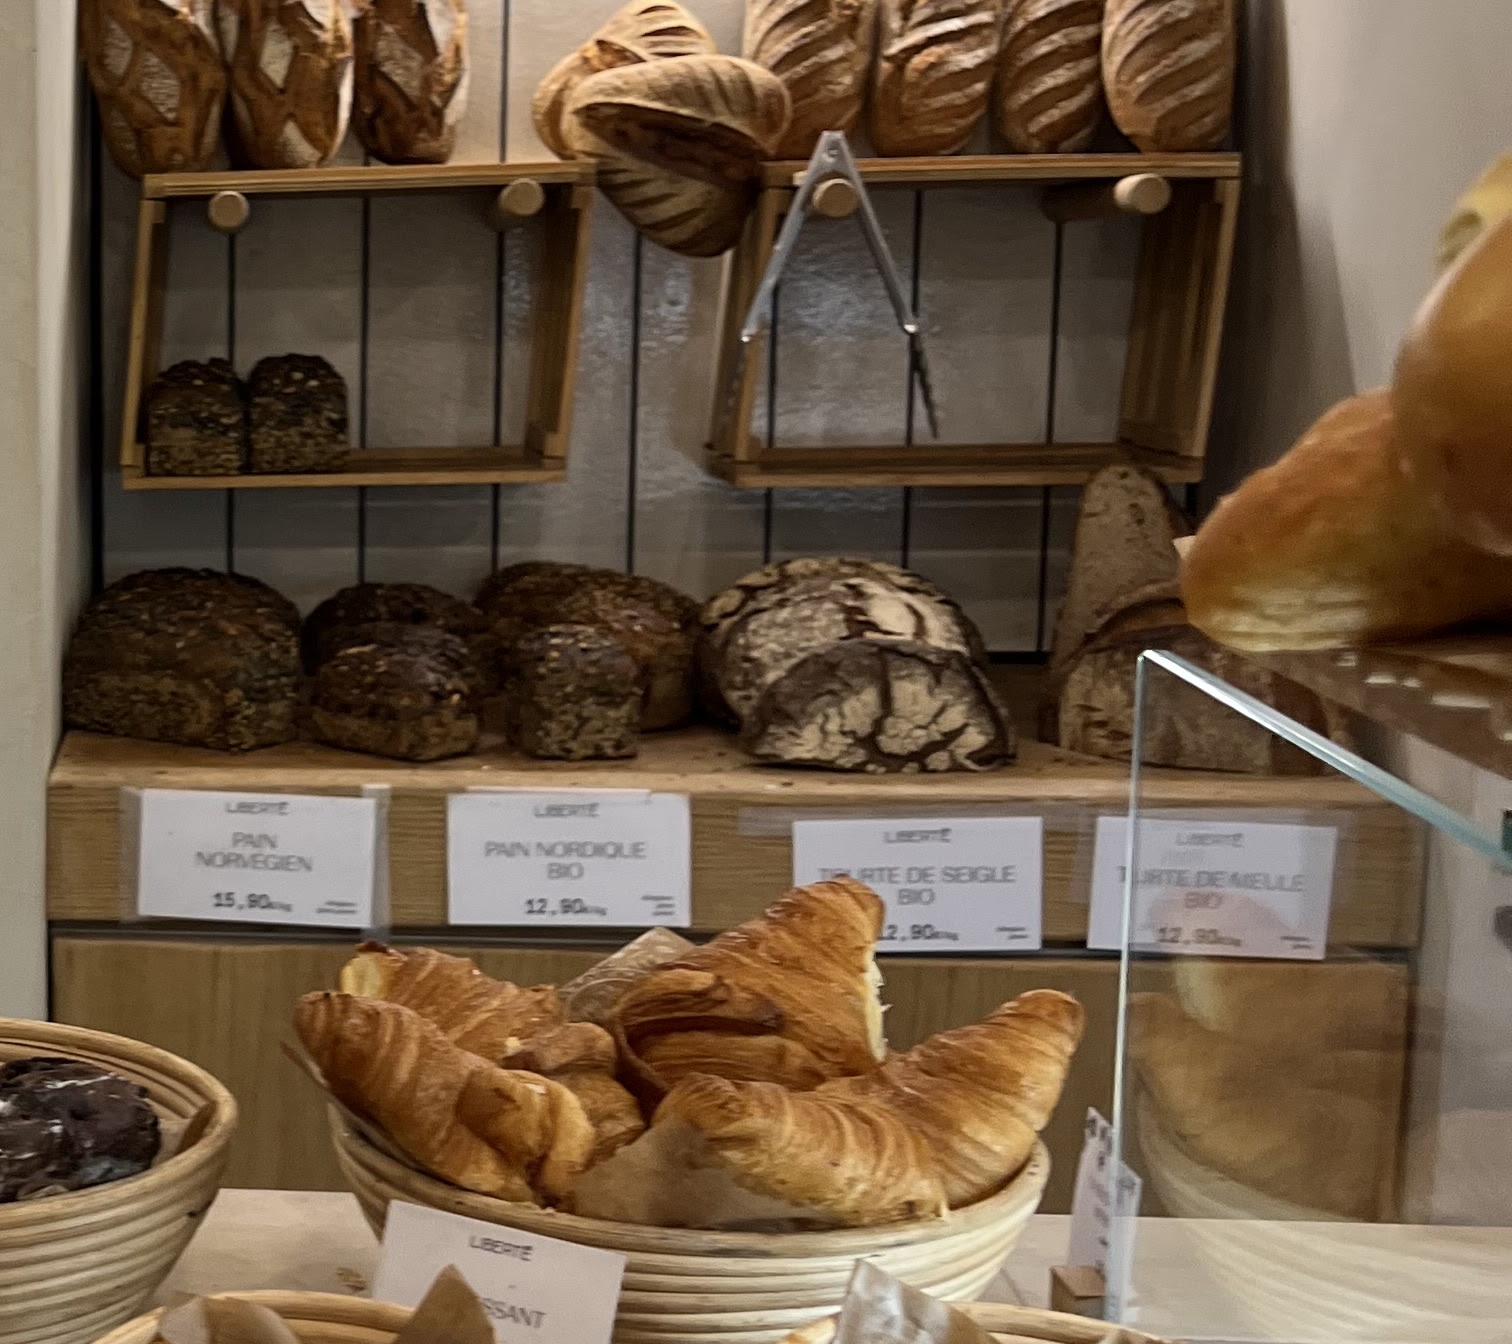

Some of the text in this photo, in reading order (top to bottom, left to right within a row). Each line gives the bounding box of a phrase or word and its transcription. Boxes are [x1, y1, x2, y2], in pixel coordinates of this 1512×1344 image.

[232, 831, 278, 849] PAIN
[485, 841, 647, 859] PAIN NORDIQUE
[547, 861, 585, 880] BIO
[906, 866, 937, 884] DE
[942, 864, 1017, 884] SEIGLE
[1194, 870, 1228, 888] DE
[897, 888, 936, 906] BIO
